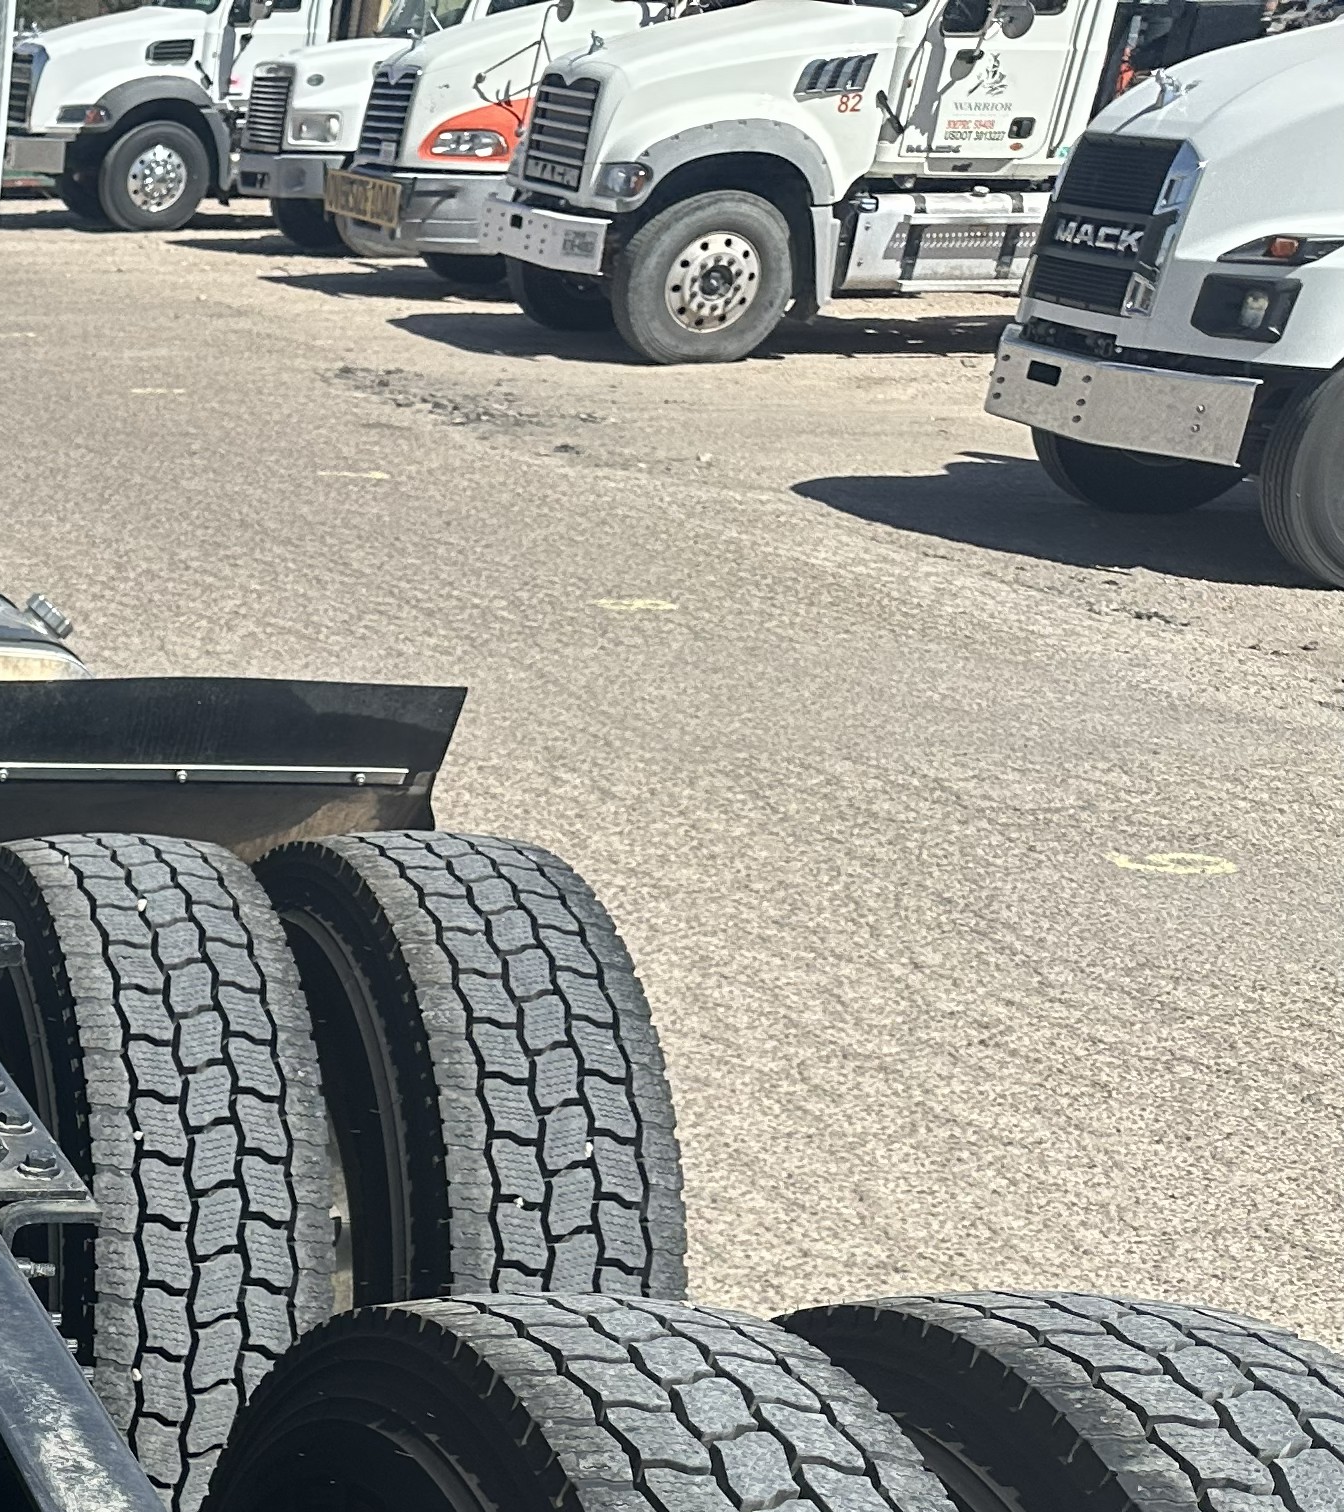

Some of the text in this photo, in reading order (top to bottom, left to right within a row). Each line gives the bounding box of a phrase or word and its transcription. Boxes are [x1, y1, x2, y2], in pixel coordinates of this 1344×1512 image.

[837, 93, 863, 113] 82
[953, 101, 1013, 111] WARRIOR
[1055, 219, 1145, 252] MACK
